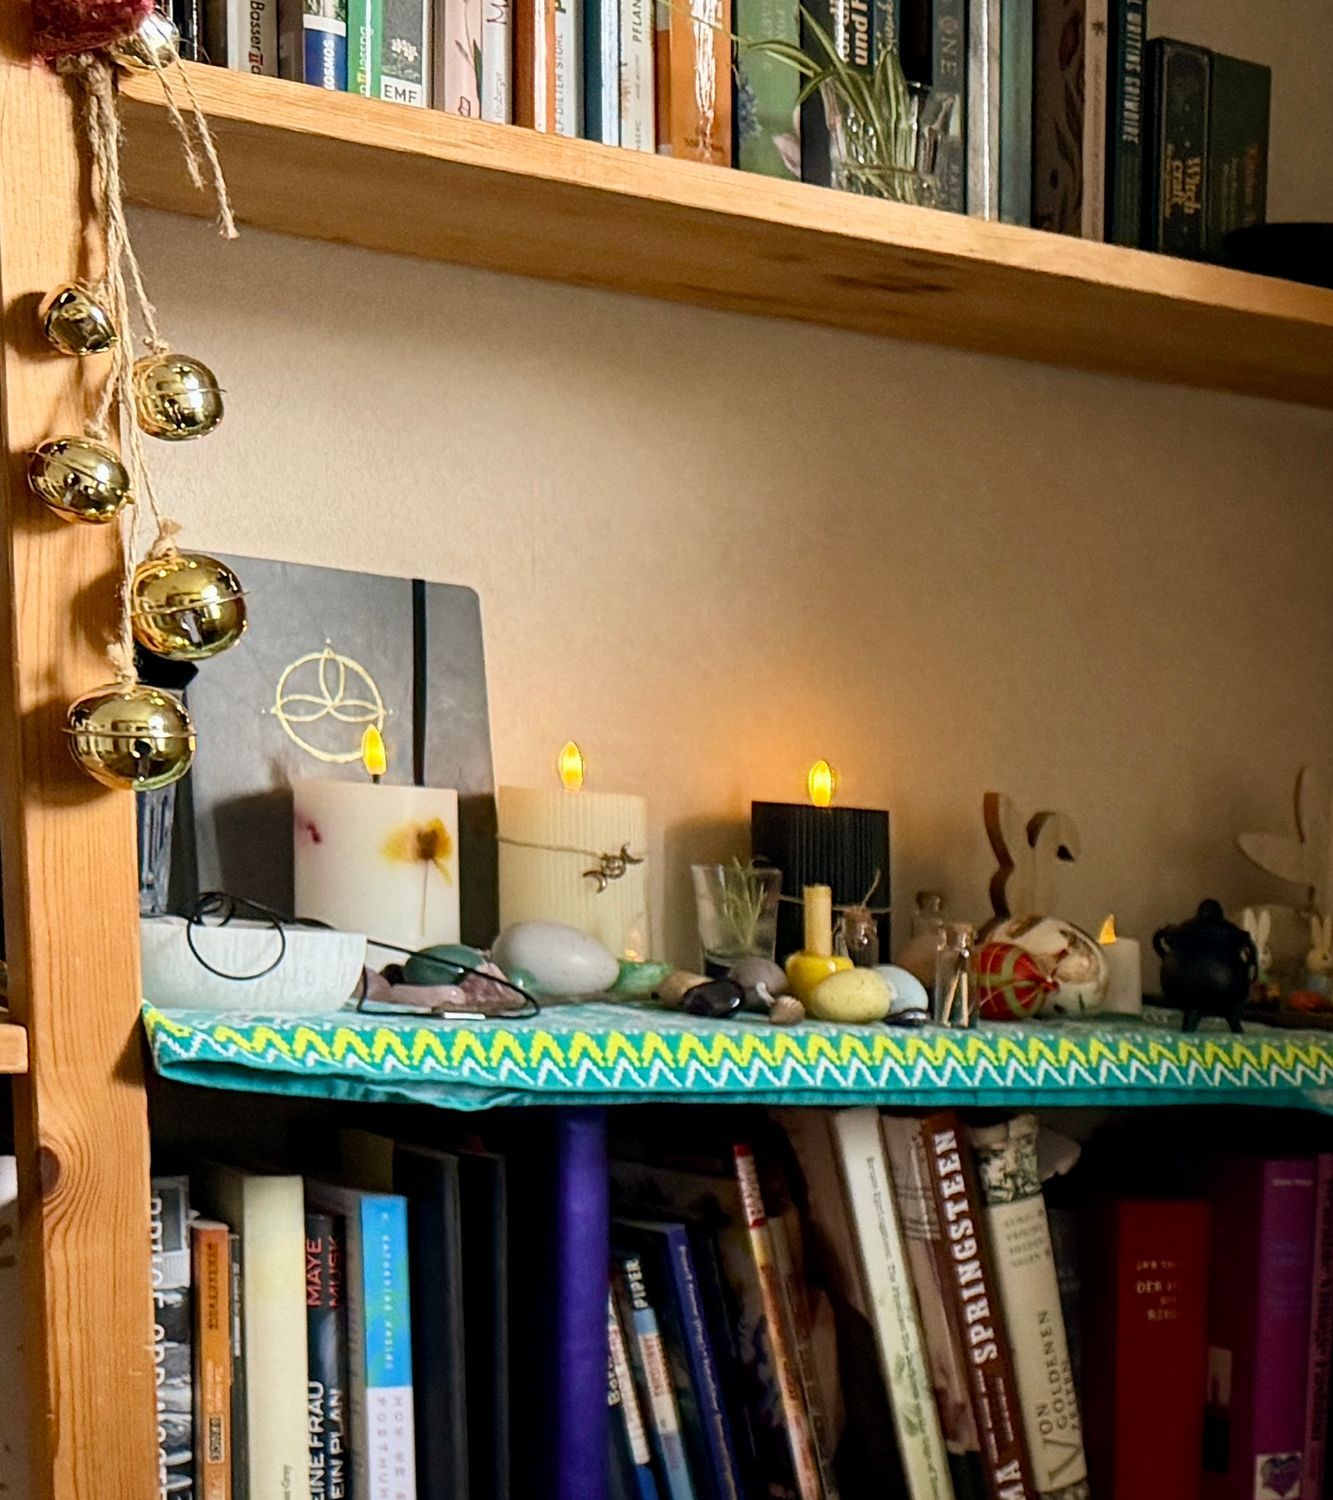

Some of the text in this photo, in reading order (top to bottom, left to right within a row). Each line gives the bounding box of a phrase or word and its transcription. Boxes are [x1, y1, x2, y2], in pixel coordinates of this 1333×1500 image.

[384, 84, 418, 104] EMF
[307, 1237, 323, 1306] MAYE
[933, 1128, 999, 1366] SPRINGSTEEN
[624, 1258, 649, 1310] PIPER
[1037, 1309, 1069, 1429] GOLDENEN
[309, 1380, 325, 1449] FRAU
[328, 1387, 345, 1500] EIN PLAN
